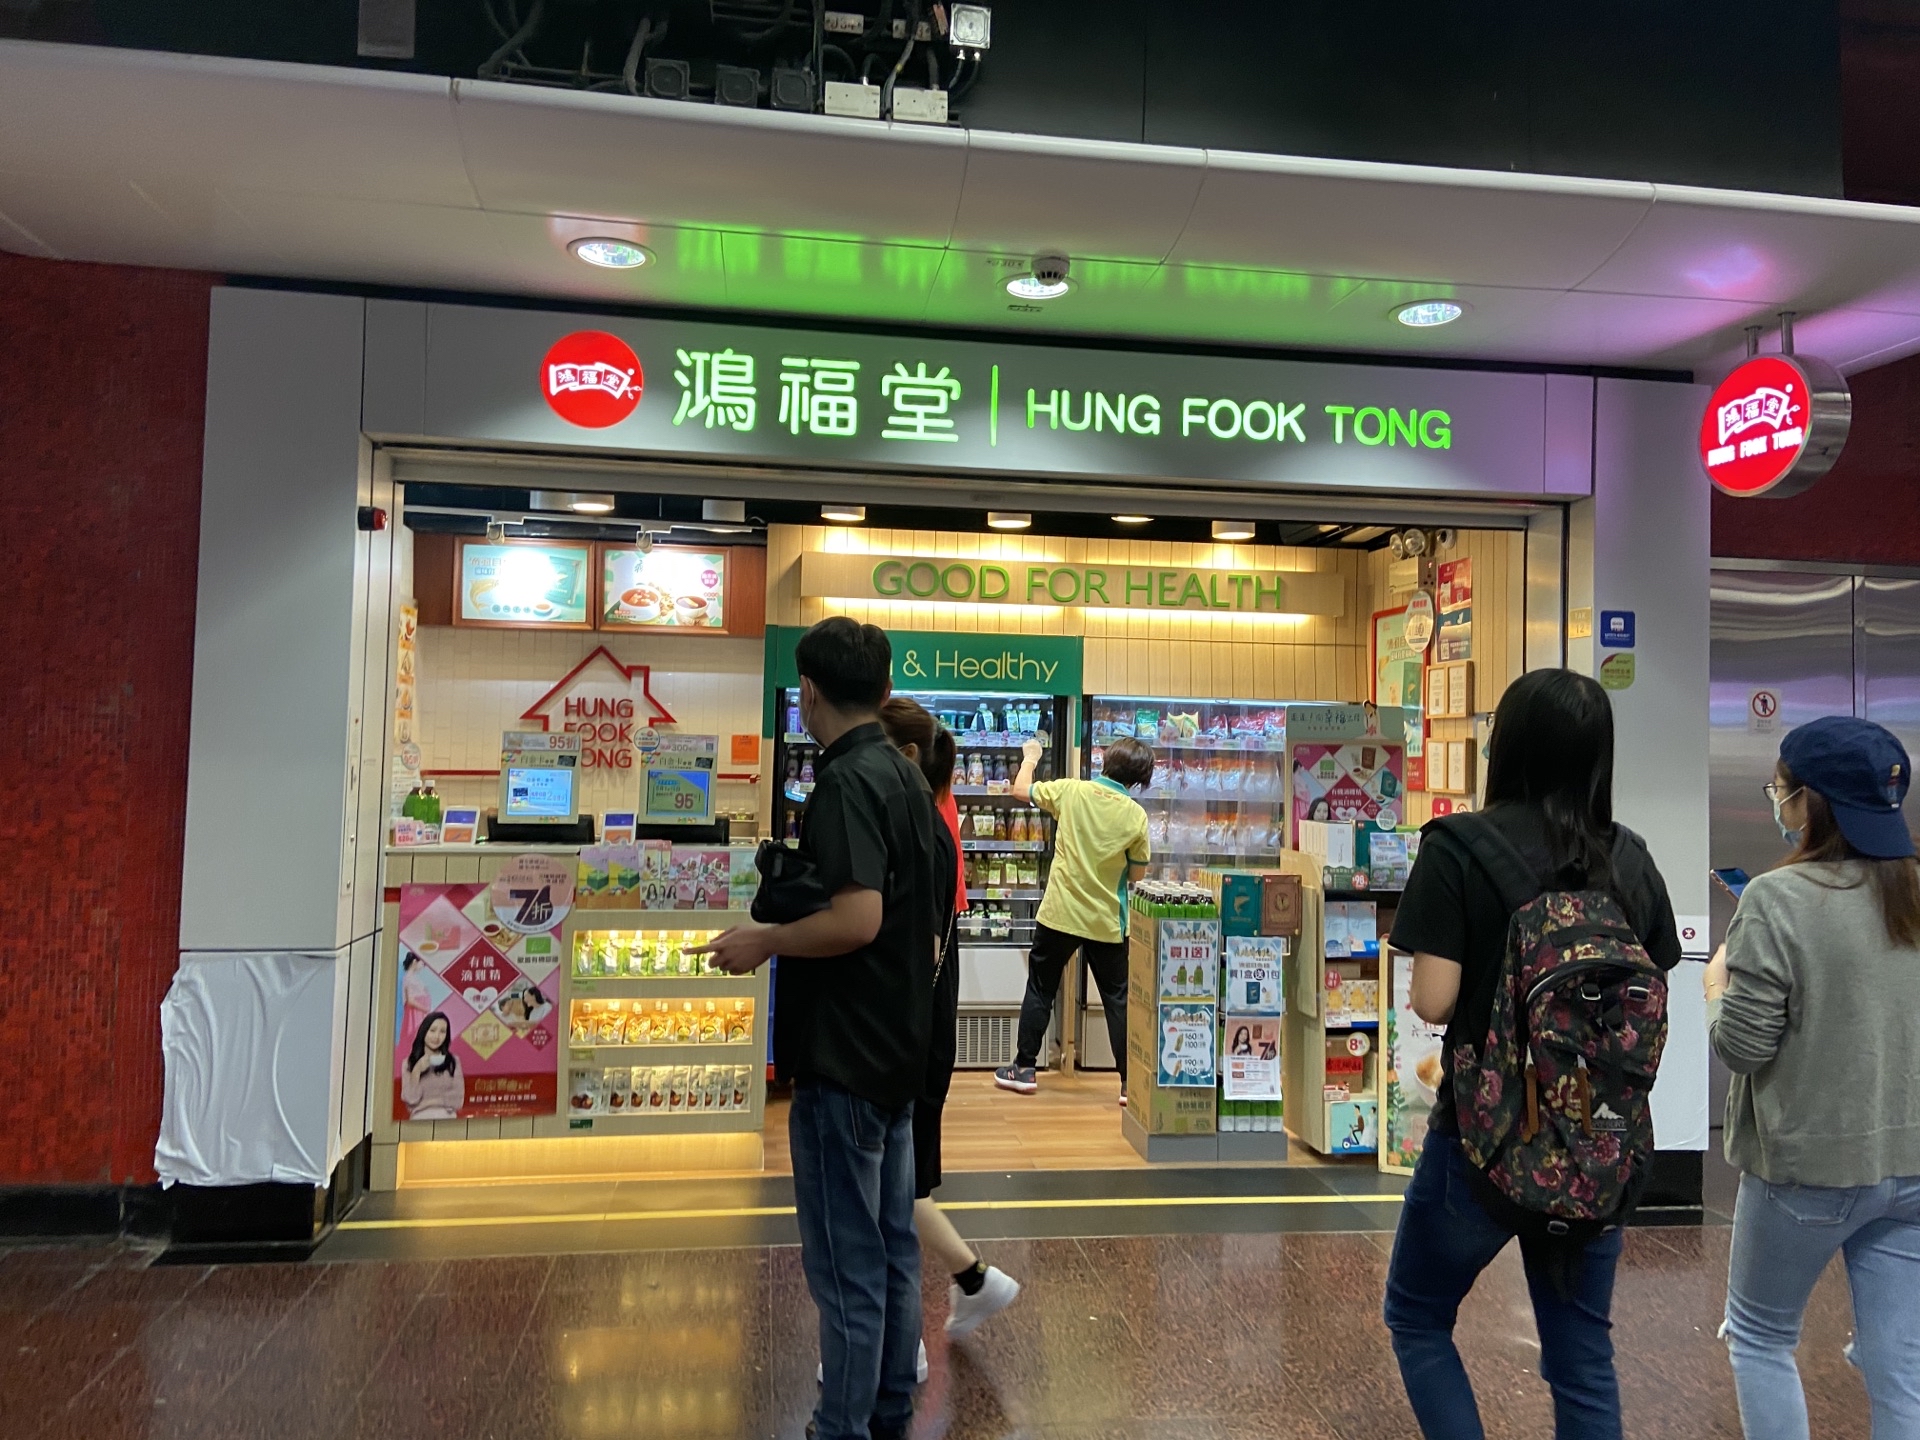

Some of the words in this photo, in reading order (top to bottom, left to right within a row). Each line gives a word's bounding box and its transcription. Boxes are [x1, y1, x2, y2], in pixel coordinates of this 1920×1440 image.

[556, 369, 620, 391] 鴻福堂
[672, 348, 961, 443] 鴻福堂
[1025, 386, 1160, 436] HUNG
[1181, 397, 1306, 443] FOOK
[1324, 405, 1451, 452] TONG
[872, 560, 1009, 598] GOOD
[1026, 567, 1109, 604] FOR
[1124, 570, 1282, 608] HEALTH
[902, 649, 927, 679] &
[935, 651, 1059, 684] Healthy
[564, 697, 633, 718] HUNG
[564, 722, 633, 743] FOOK
[581, 748, 632, 769] ONG
[674, 792, 694, 810] 95
[469, 955, 495, 968] 有機
[461, 968, 501, 982] 滴雞精
